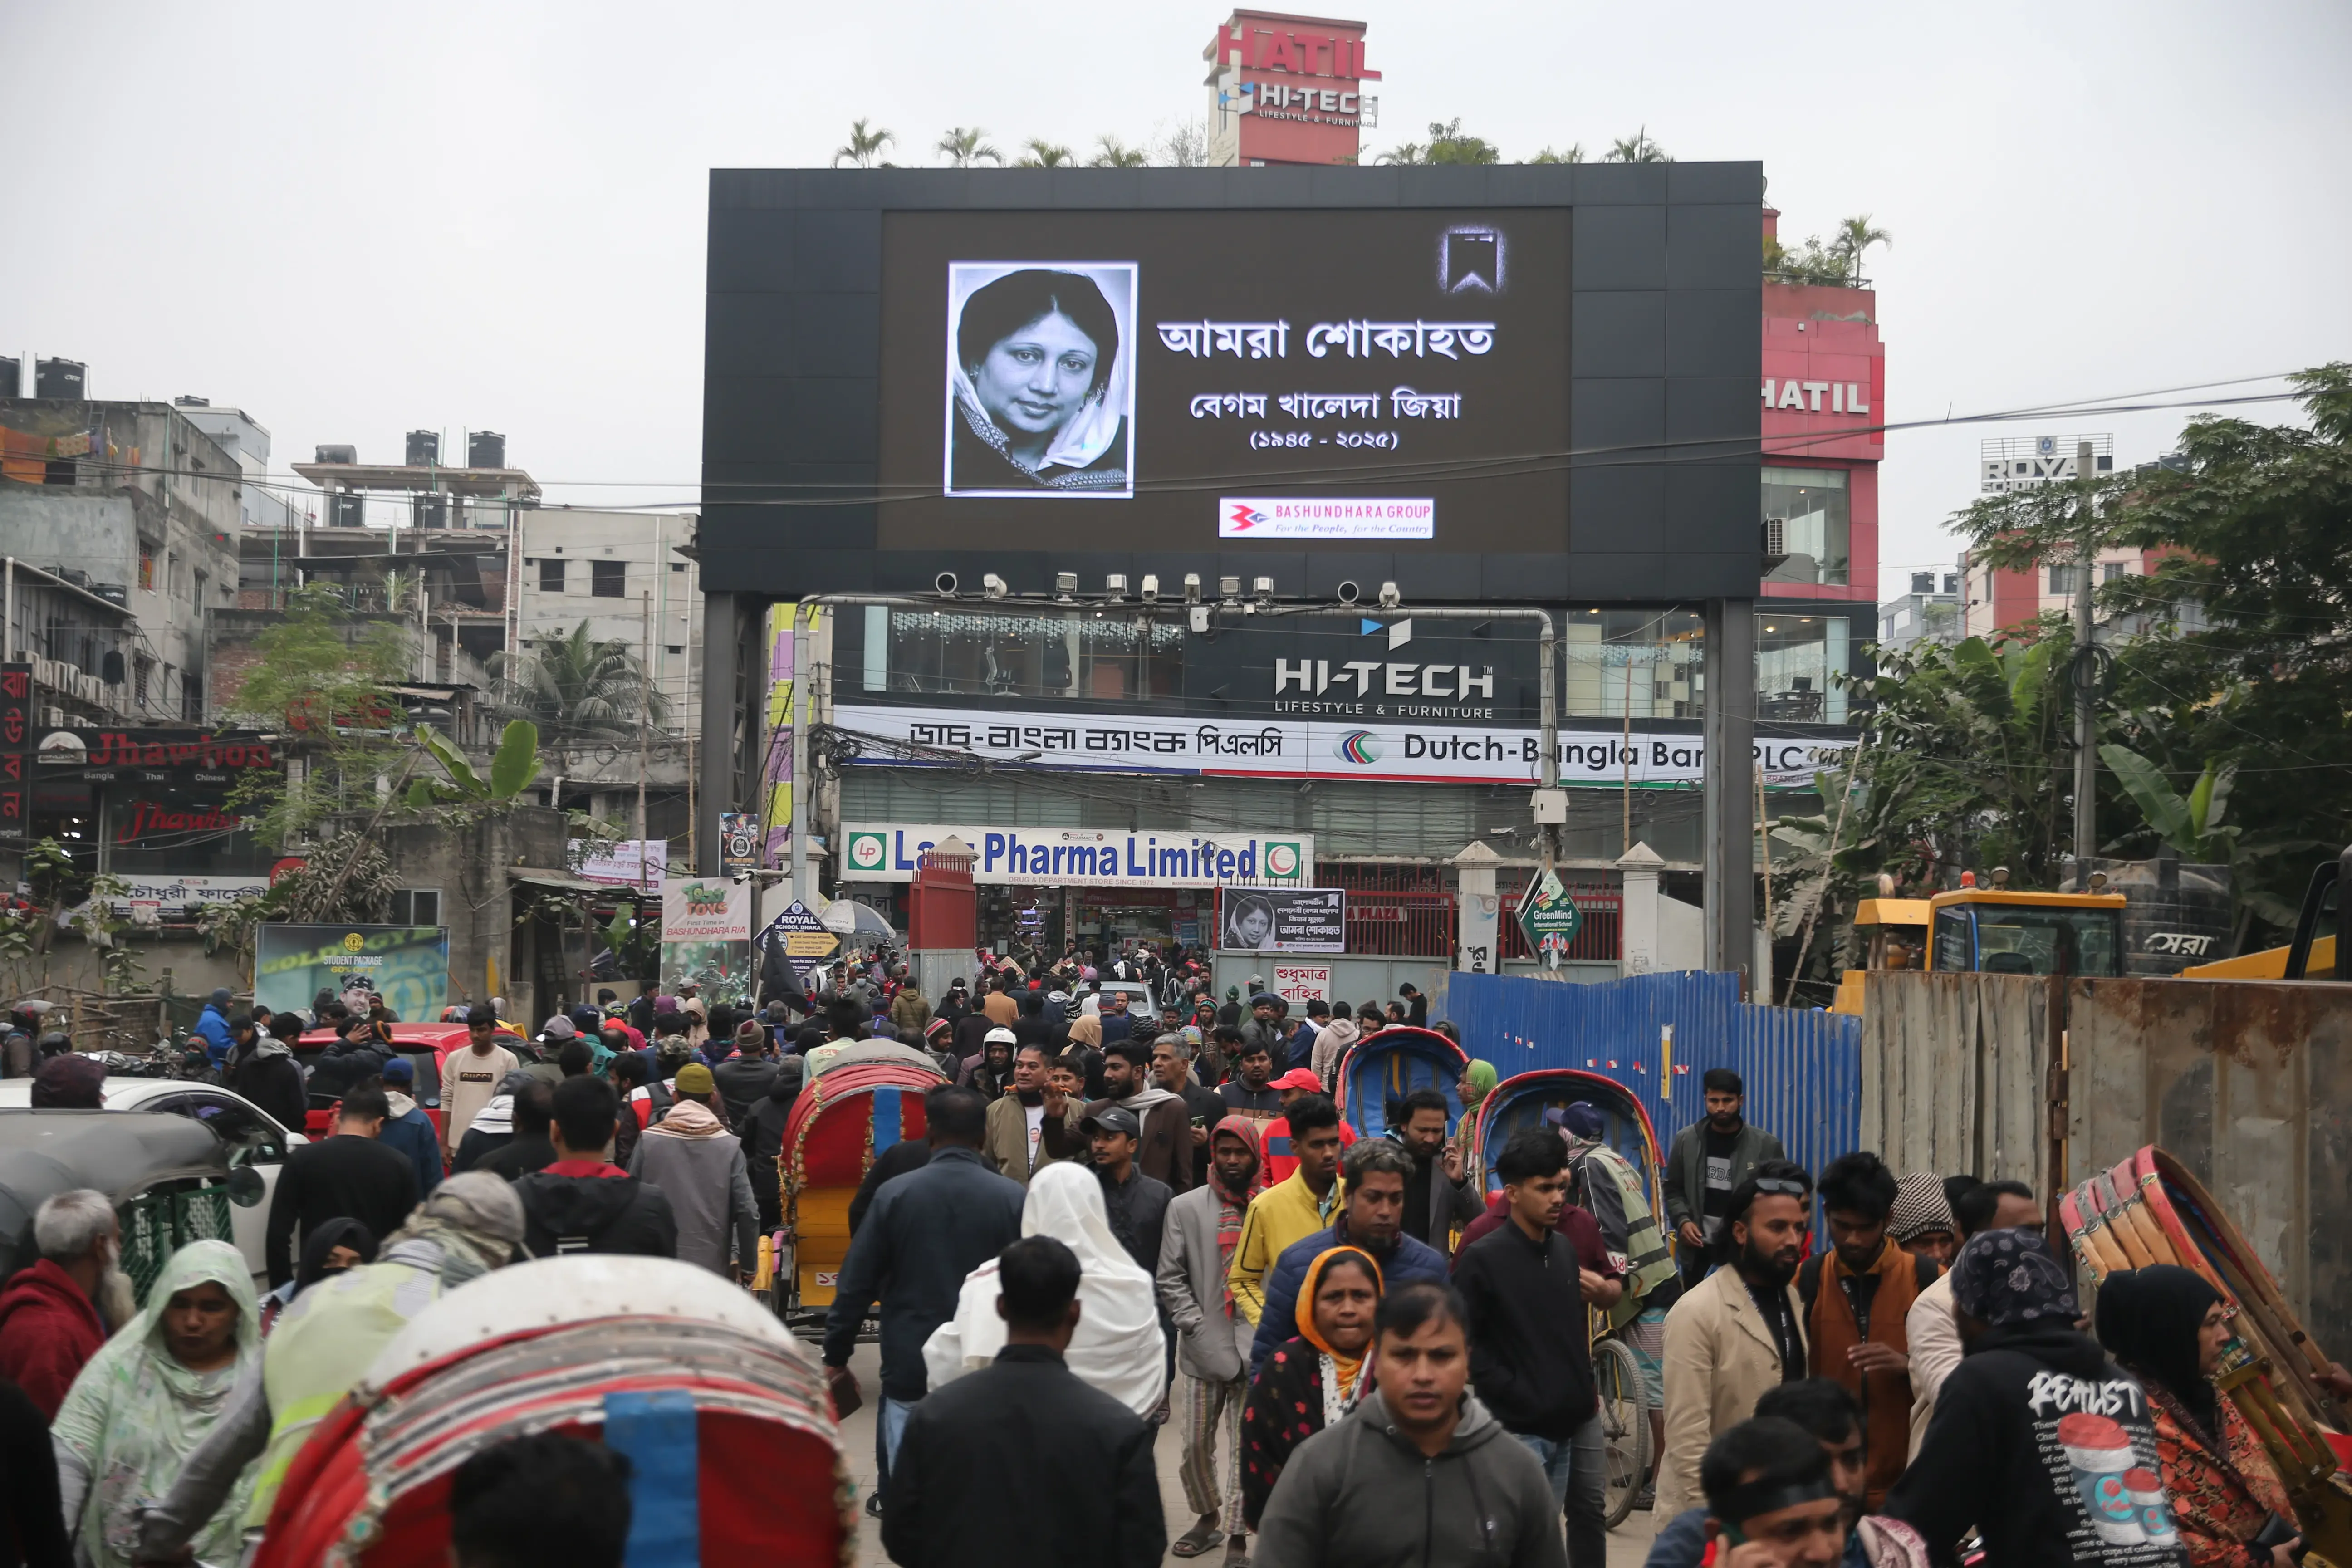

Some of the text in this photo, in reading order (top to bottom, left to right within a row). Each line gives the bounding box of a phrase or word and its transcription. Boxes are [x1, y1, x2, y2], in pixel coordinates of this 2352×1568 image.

[1217, 25, 1382, 81] HATIL
[1260, 83, 1378, 117] HI-TECH
[1259, 110, 1308, 122] LIFESTYLE
[1157, 319, 1496, 360] আমরা শোকাহত
[1190, 386, 1461, 420] বেগম খালেদা জিয়া
[1250, 431, 1312, 451] (১৯৪৫
[1336, 431, 1398, 451] ২০২৫)
[1276, 505, 1431, 518] BASHUNDHARA GROUP
[1275, 524, 1429, 535] For the People, for the Country
[1275, 658, 1493, 702] HI-TECH
[1275, 701, 1492, 719] LIFESTYLE & FURNITURE
[1196, 725, 1283, 756] পিএলসি
[90, 734, 273, 767] Jhawbon
[1405, 735, 1638, 770] Dutch-Bngla
[84, 772, 114, 781] Bangla
[985, 833, 1117, 875] Pharma
[1127, 837, 1256, 879] Limited
[686, 902, 728, 916] TOYS
[1534, 910, 1572, 920] GreenMind
[782, 916, 816, 924] ROYAL
[667, 927, 729, 935] BASHUNDHARA
[1280, 926, 1340, 936] আমরা শোকাহত
[324, 956, 382, 965] STUDENT PACKAGE
[1276, 966, 1327, 985] শুধুমাত্র
[1280, 985, 1321, 1003] বাহির
[2049, 1465, 2070, 1474] such
[2053, 1477, 2069, 1486] you
[2071, 1540, 2094, 1549] some
[2073, 1551, 2101, 1560] billion
[2102, 1548, 2122, 1558] cups
[2134, 1545, 2161, 1553] coffee
[2104, 1557, 2128, 1566] every
